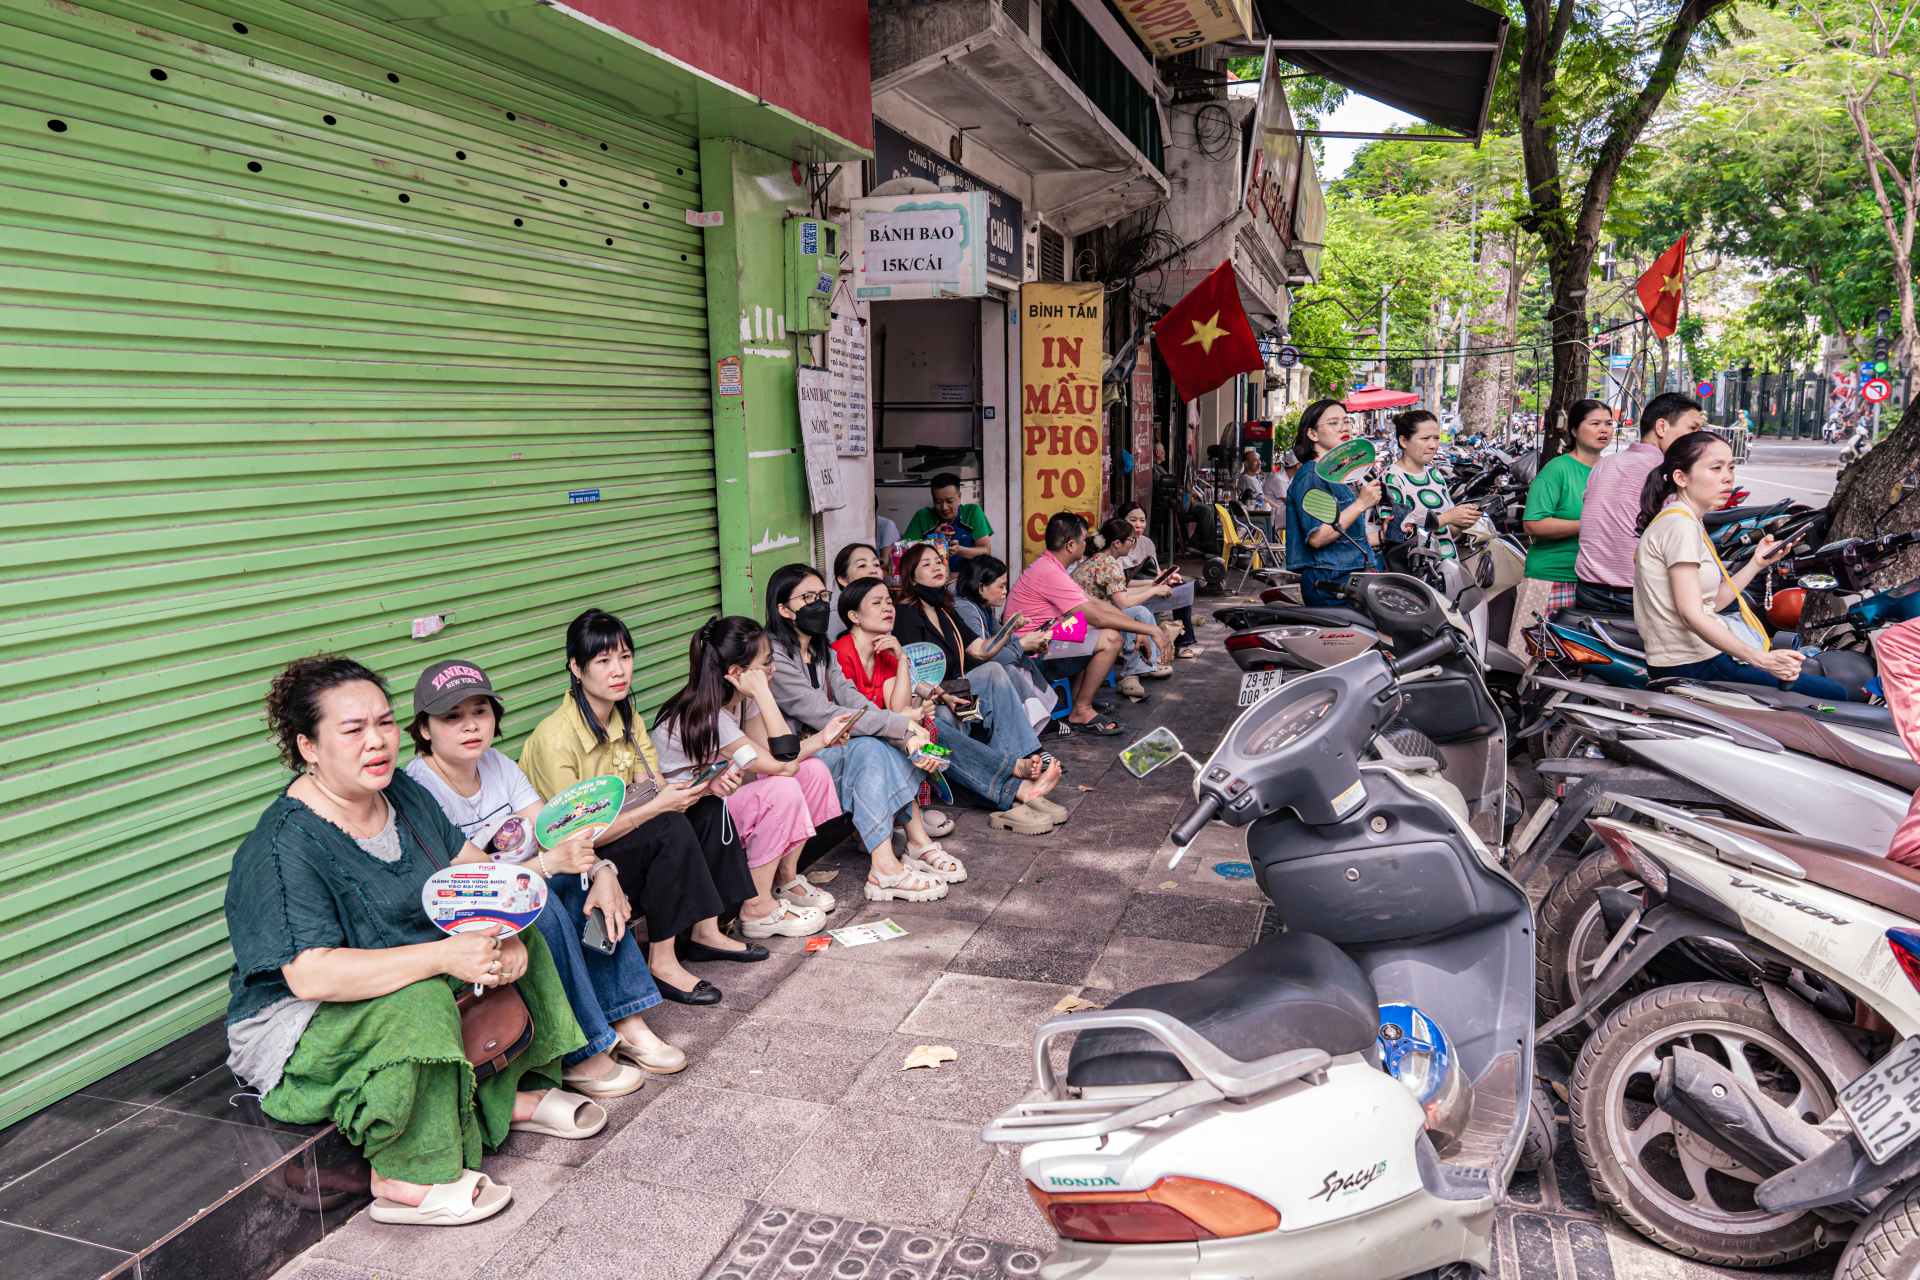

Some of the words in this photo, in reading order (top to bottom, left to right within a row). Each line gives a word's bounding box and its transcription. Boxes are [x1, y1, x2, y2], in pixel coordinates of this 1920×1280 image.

[1170, 30, 1205, 49] 26
[908, 149, 927, 169] CÔNG
[928, 159, 936, 174] TY
[869, 225, 915, 242] BÁNH
[919, 226, 954, 241] BAO
[990, 218, 1014, 255] CHÂU
[881, 254, 943, 272] 15K/CÁI
[1029, 302, 1063, 318] BÌNH
[1067, 302, 1098, 319] TÂM
[1041, 337, 1084, 368] IN
[811, 416, 830, 434] NÓNG
[1024, 425, 1099, 456] PHO
[820, 468, 834, 486] 15K
[1036, 468, 1086, 499] TO
[431, 665, 484, 692] YANKEES
[445, 679, 460, 689] NEW
[1246, 671, 1276, 688] 29-BF
[1729, 874, 1853, 926] VISION
[1845, 1073, 1912, 1154] 360.12
[1050, 1176, 1120, 1187] HONDA
[1308, 1164, 1378, 1202] Spacy
